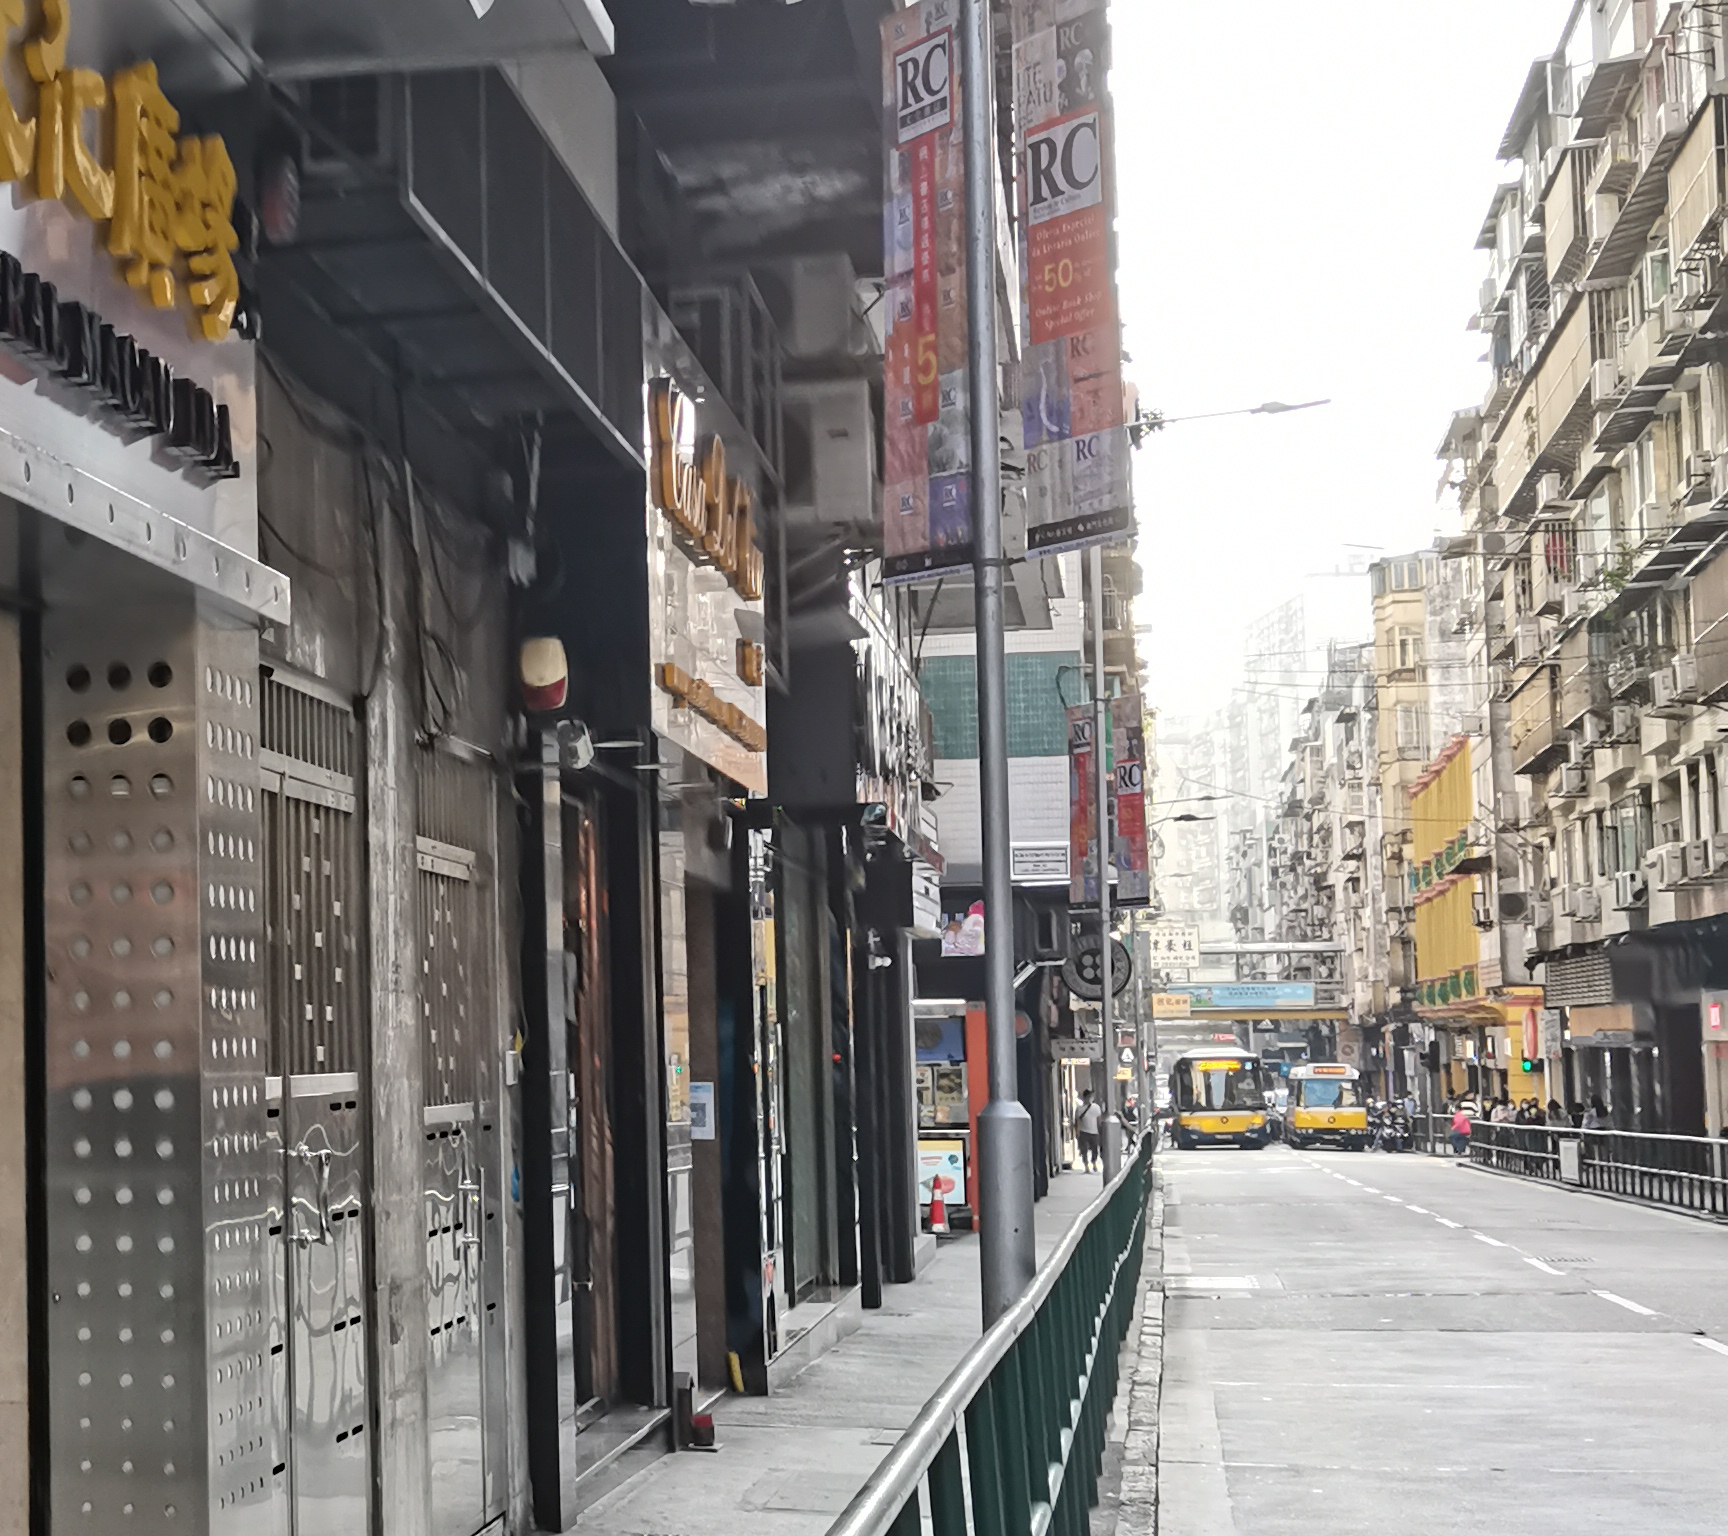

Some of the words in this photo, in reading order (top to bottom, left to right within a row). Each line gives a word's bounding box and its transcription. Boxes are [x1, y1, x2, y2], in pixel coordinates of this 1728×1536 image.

[898, 38, 948, 112] RC
[1027, 117, 1099, 208] RC
[1044, 258, 1073, 292] 50
[1027, 448, 1049, 475] RC
[1075, 434, 1100, 462] RC
[1073, 720, 1093, 744] RC
[1119, 764, 1142, 790] RC
